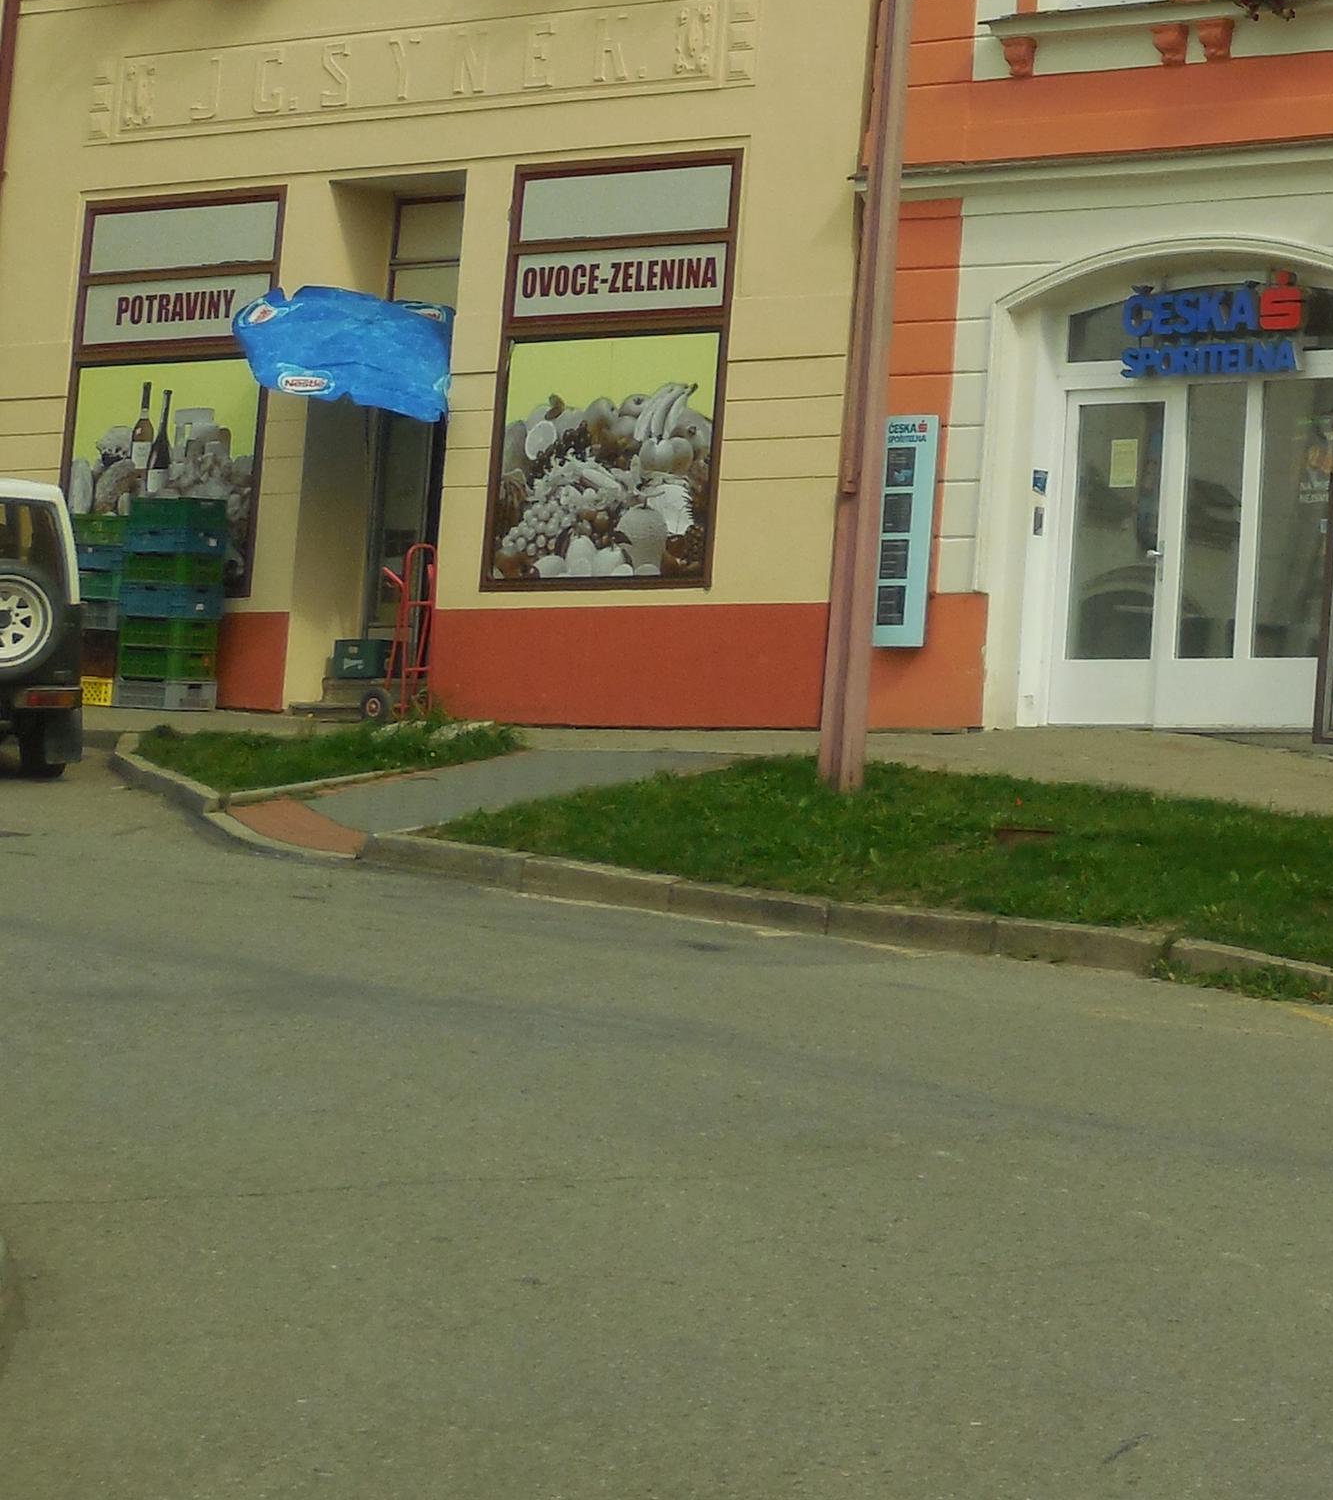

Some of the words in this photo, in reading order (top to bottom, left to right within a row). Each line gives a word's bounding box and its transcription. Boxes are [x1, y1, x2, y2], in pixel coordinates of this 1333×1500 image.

[521, 256, 718, 298] OVOCE-ZELENINA
[115, 289, 237, 326] POTRAVINY
[1122, 280, 1260, 338] ČESKÁ
